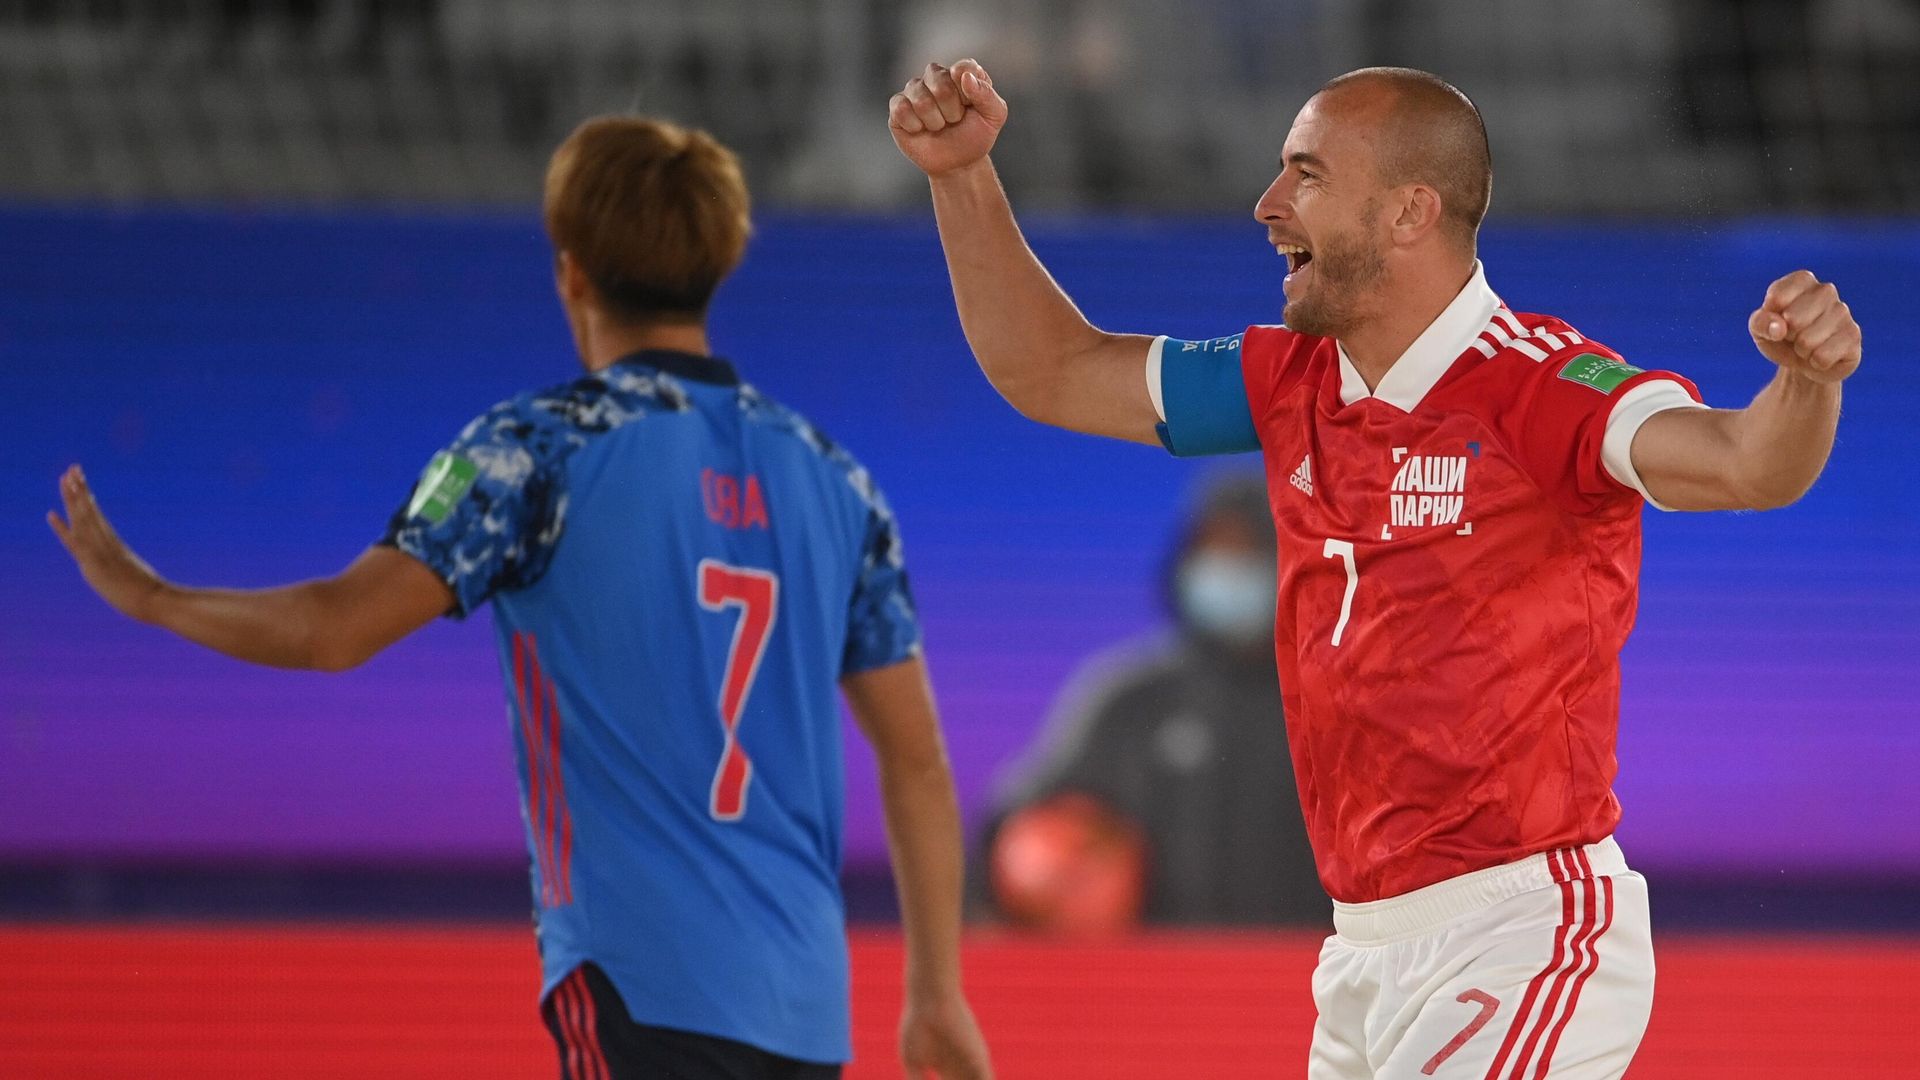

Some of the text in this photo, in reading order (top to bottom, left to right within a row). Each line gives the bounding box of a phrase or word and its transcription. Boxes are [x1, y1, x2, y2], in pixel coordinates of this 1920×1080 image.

[1390, 494, 1464, 526] ПАРНИ
[1391, 456, 1467, 492] НАШИ
[1323, 538, 1358, 647] 7
[698, 558, 779, 821] 7
[1420, 987, 1501, 1075] 7
